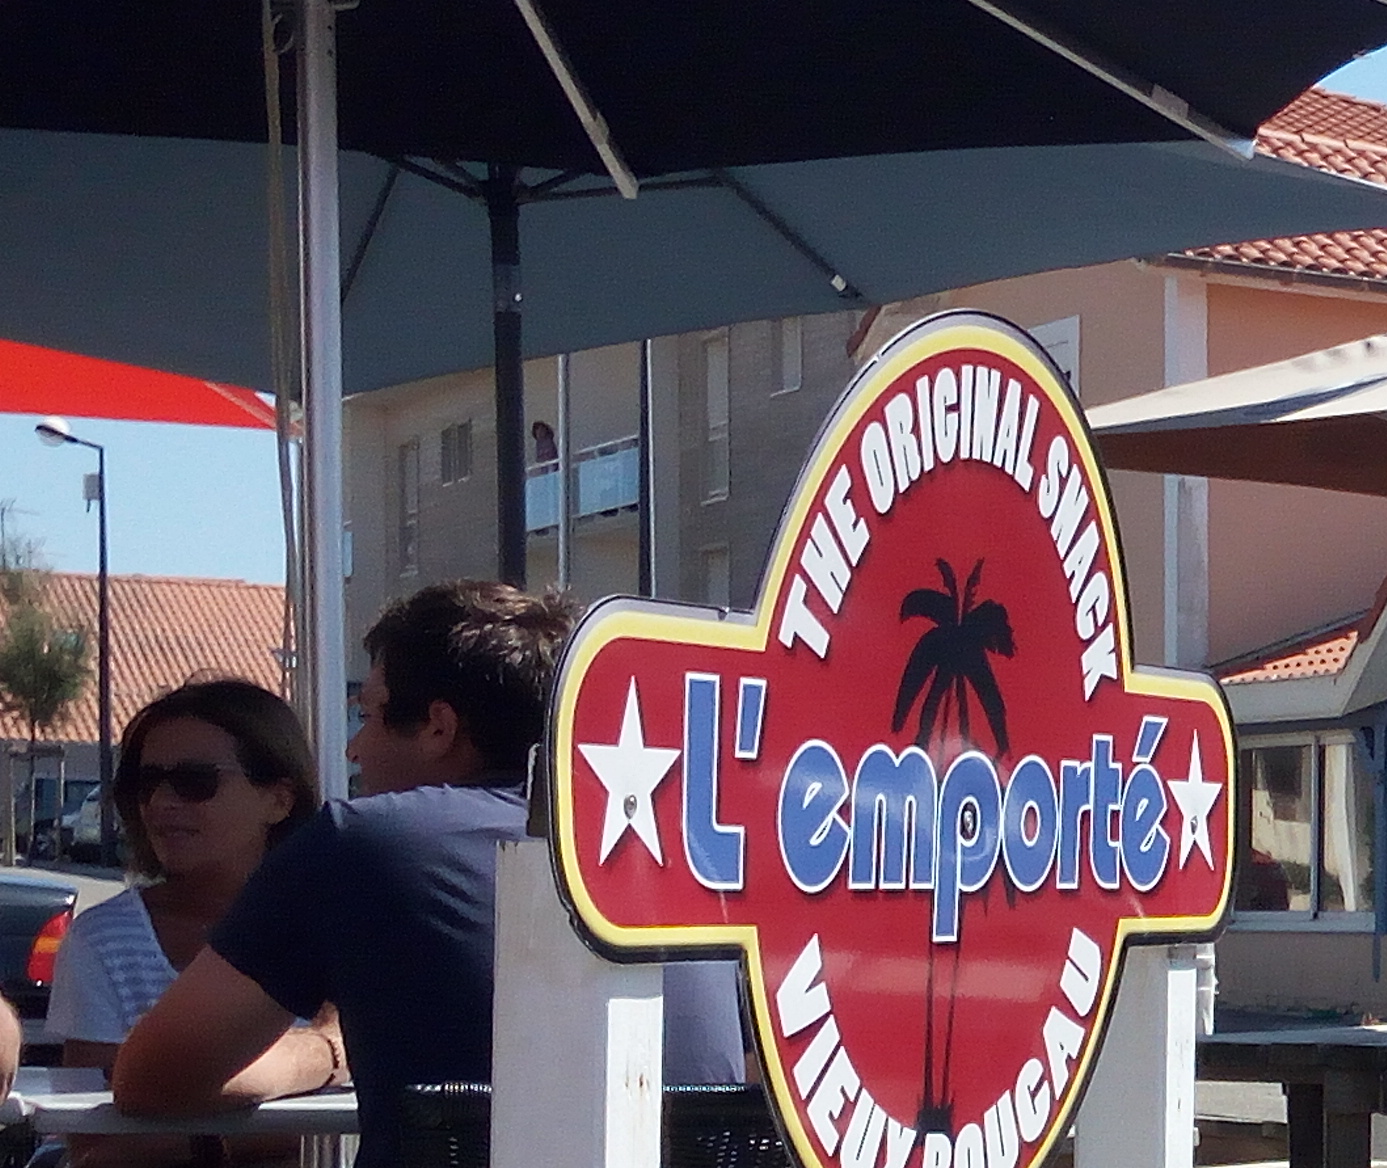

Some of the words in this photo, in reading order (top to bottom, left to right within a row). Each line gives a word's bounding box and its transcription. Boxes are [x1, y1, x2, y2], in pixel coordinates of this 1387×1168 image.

[778, 463, 871, 660] THE
[860, 364, 1041, 515] ORIGINAL
[1038, 435, 1118, 702] SNACK
